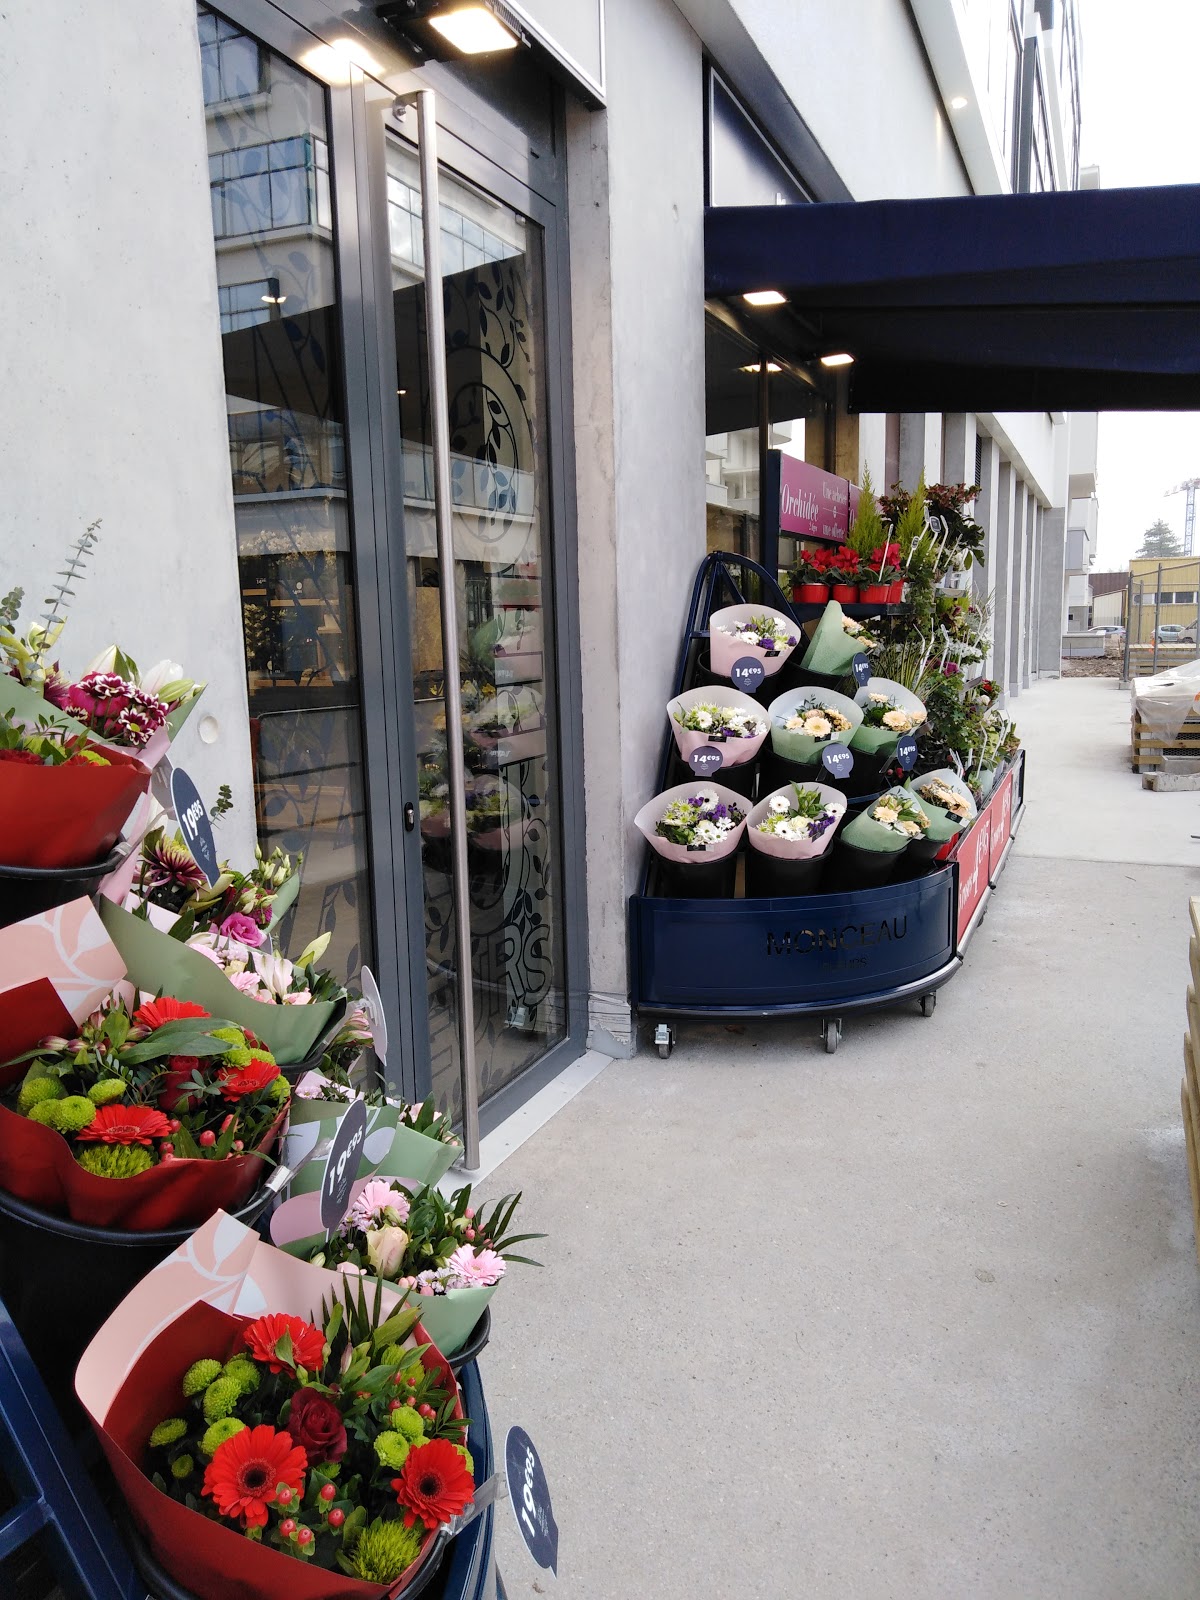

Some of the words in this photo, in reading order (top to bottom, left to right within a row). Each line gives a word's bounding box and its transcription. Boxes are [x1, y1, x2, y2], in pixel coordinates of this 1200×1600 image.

[781, 484, 819, 521] Orchidée
[736, 668, 762, 678] 14€95
[854, 662, 869, 673] 14€95
[693, 755, 720, 763] 14€95
[826, 753, 850, 765] 14€95
[899, 745, 916, 757] 14€95
[181, 799, 204, 841] 19€95
[766, 916, 907, 956] MONCEAU
[328, 1124, 364, 1196] 19€95
[521, 1446, 536, 1538] 19€95
